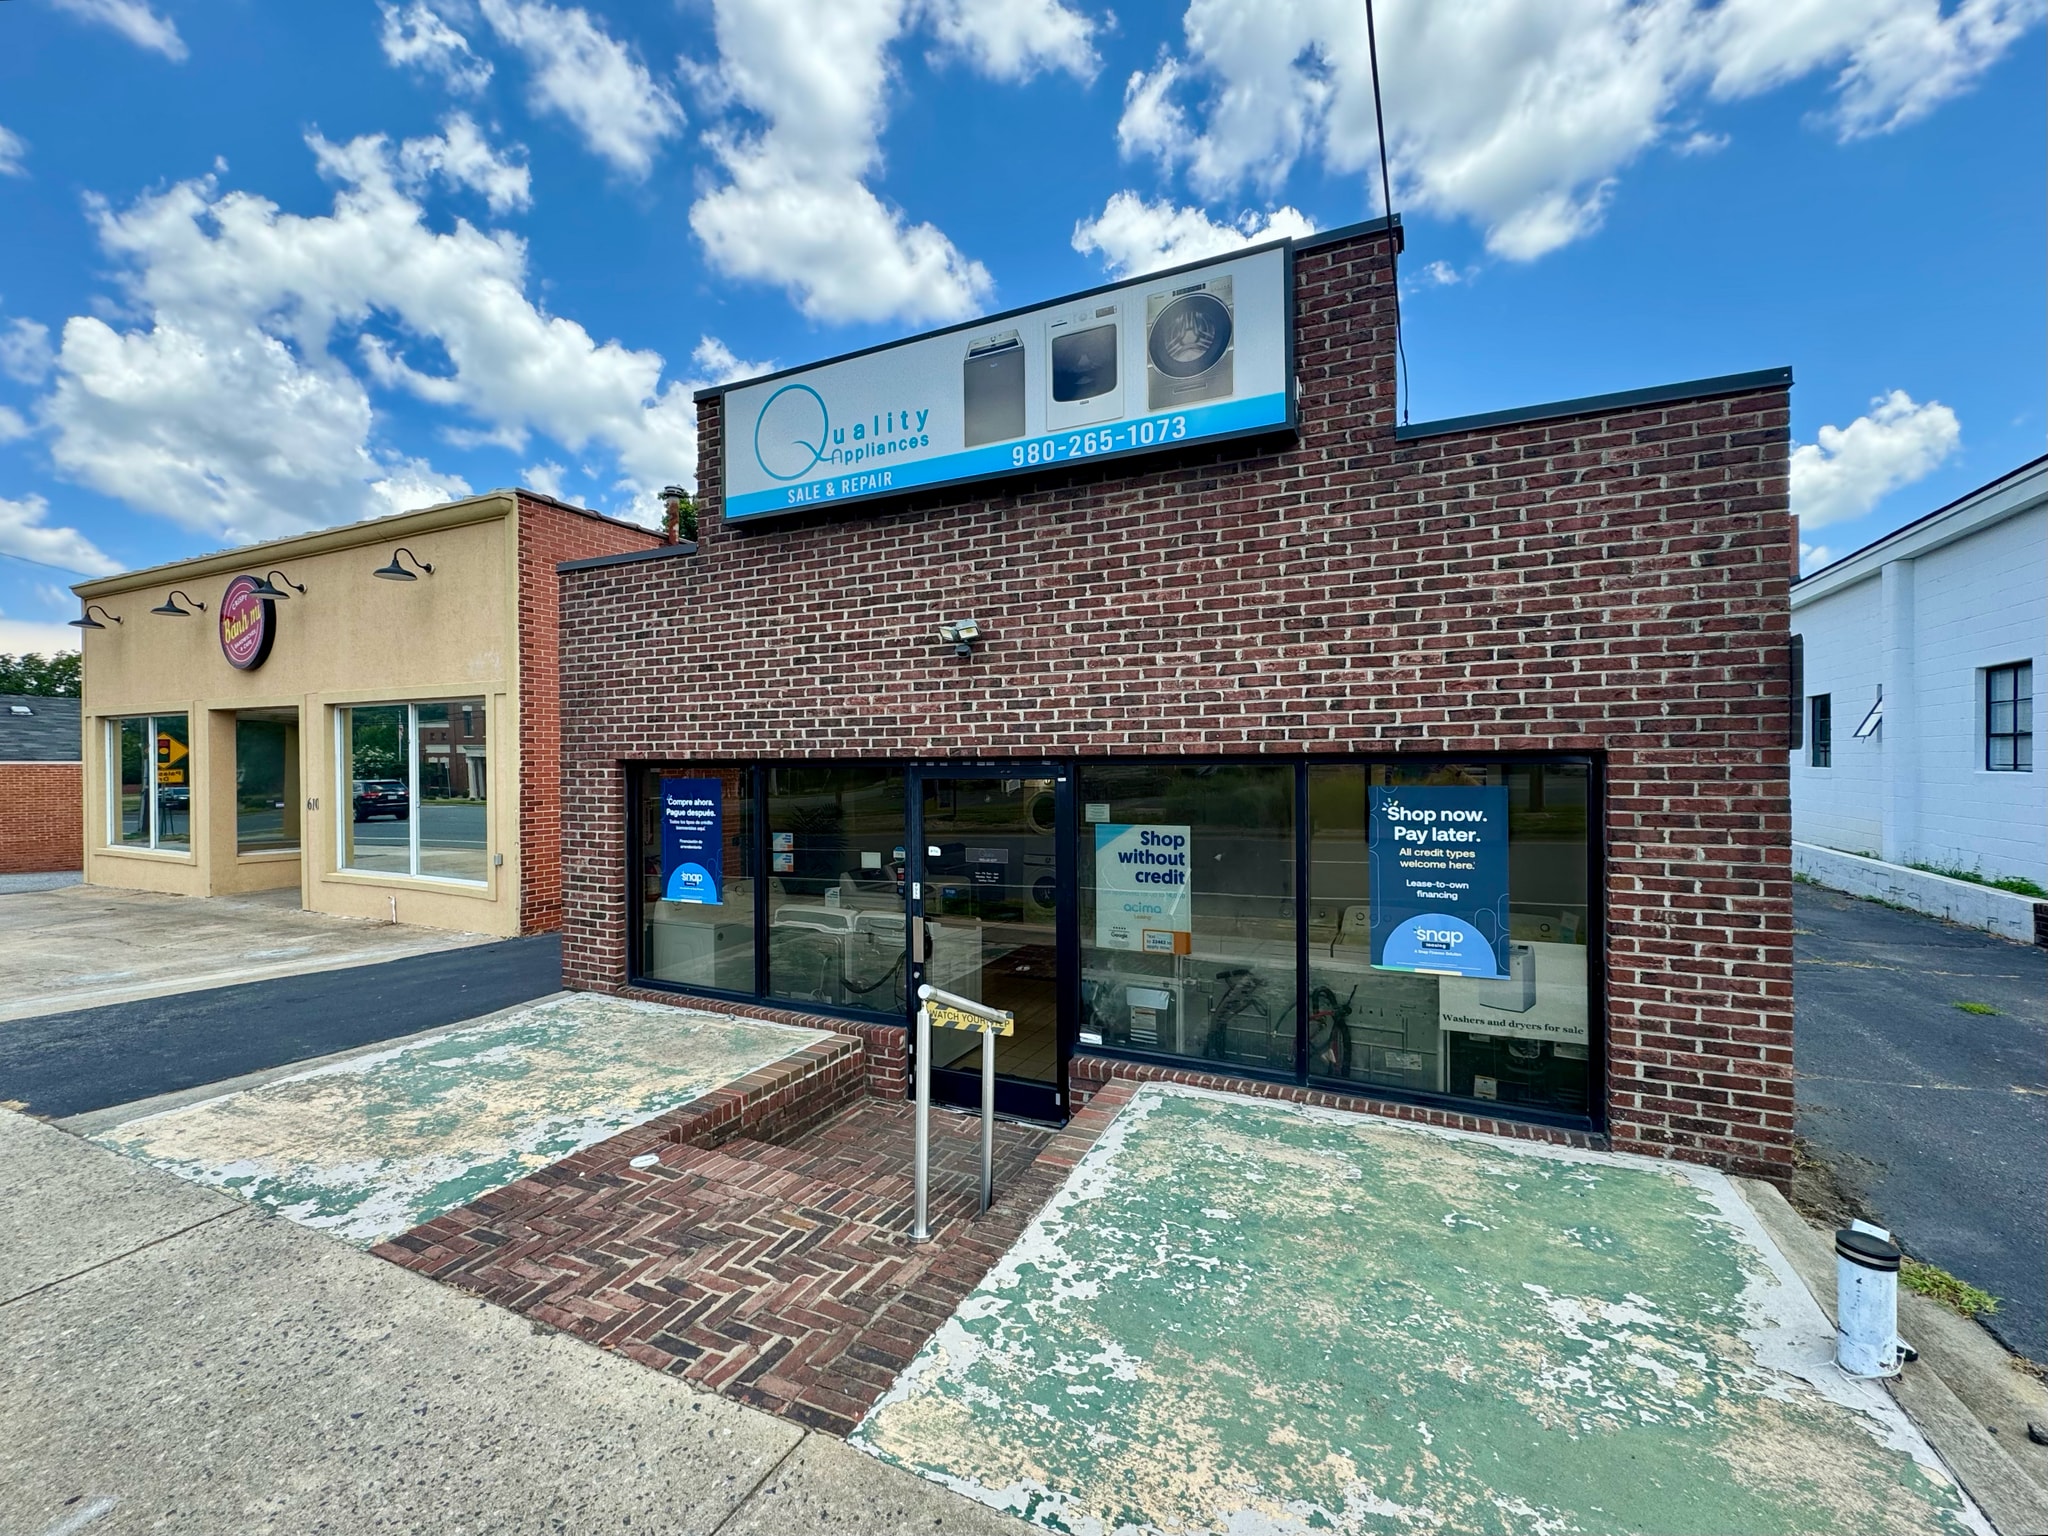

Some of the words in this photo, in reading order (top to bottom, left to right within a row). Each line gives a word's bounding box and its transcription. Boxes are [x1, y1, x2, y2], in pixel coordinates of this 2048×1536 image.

[754, 383, 930, 482] Quality
[1012, 415, 1187, 467] 980-265-1073
[831, 434, 930, 466] Appliances
[787, 484, 821, 504] SALE
[825, 480, 836, 497] &
[841, 471, 893, 495] REPAIR
[307, 798, 320, 811] 610
[667, 798, 693, 807] Compre
[694, 798, 715, 806] ahora.
[666, 808, 686, 818] Pague
[687, 808, 716, 818] después.
[1386, 806, 1437, 825] Shop
[1440, 811, 1488, 822] now.
[1140, 831, 1185, 850] Shop
[1394, 826, 1429, 845] Pay
[1432, 827, 1482, 842] later.
[1118, 849, 1185, 866] without
[1399, 848, 1412, 857] All
[1414, 848, 1444, 858] credit
[1446, 849, 1476, 859] types
[1400, 860, 1447, 869] welcome
[681, 871, 703, 885] snap
[1135, 869, 1185, 885] credit
[1406, 879, 1469, 890] Lease-to-own
[1416, 890, 1459, 901] financing
[1123, 902, 1162, 913] acima
[1415, 928, 1464, 947] snap
[930, 1009, 959, 1020] WATCH
[962, 1013, 986, 1024] YOUR
[1443, 1014, 1485, 1025] Washers
[1487, 1019, 1506, 1028] and
[1508, 1020, 1542, 1030] dryers
[1544, 1023, 1560, 1032] for
[1562, 1025, 1584, 1035] sale
